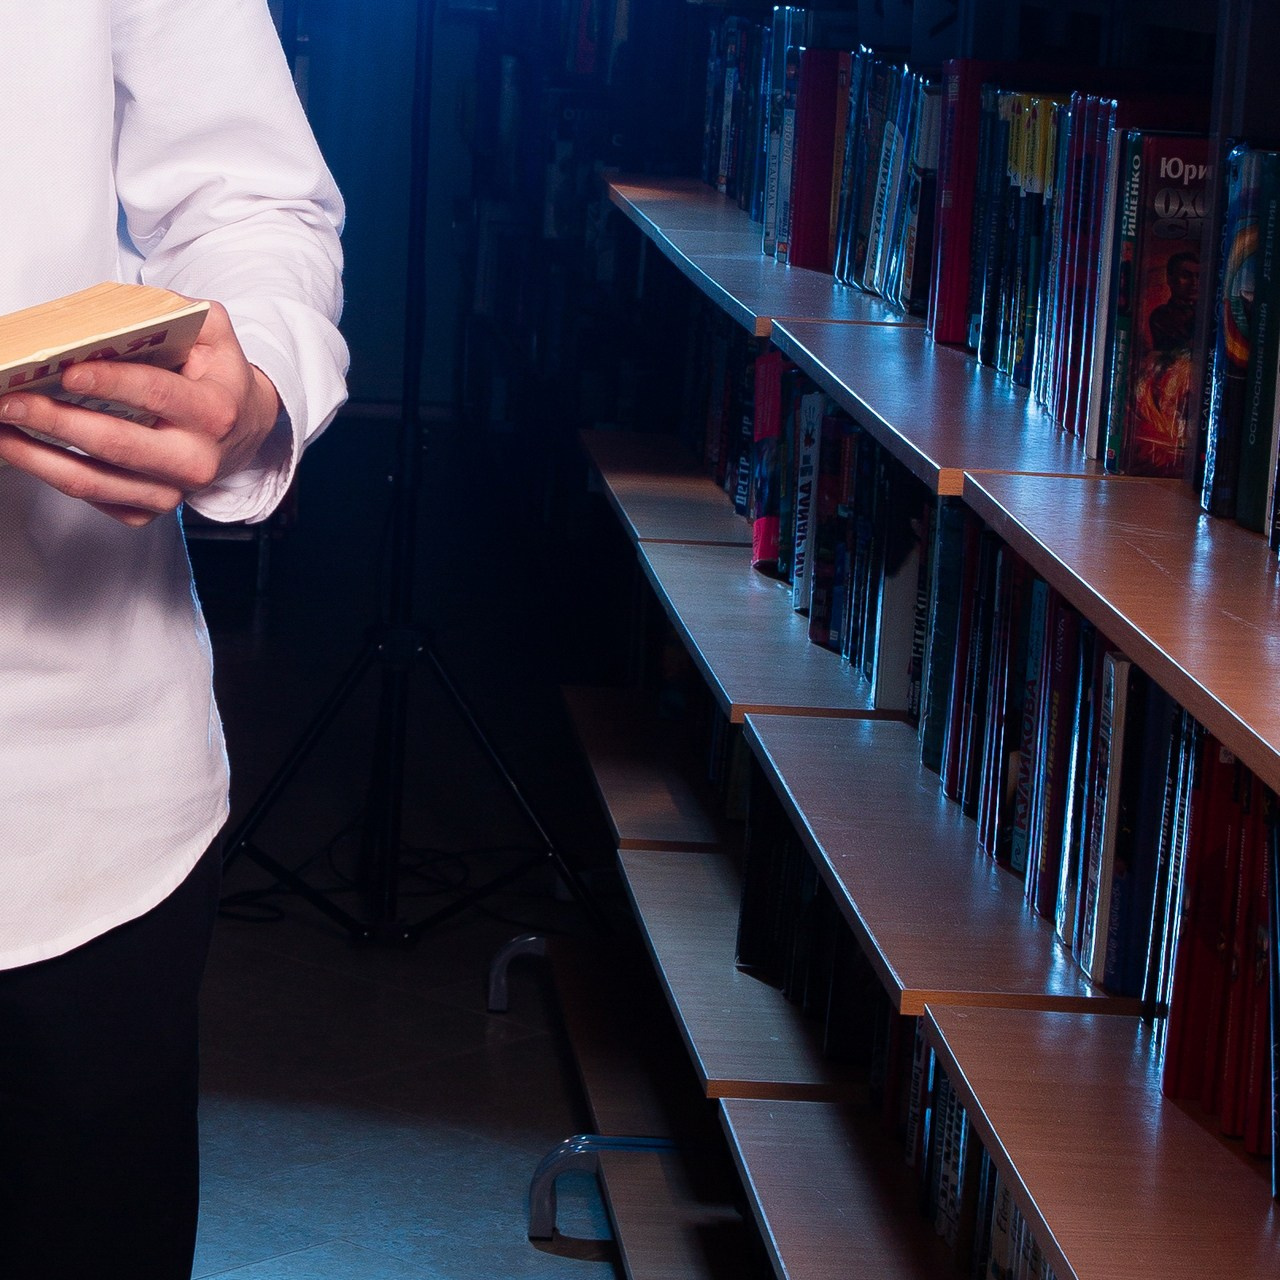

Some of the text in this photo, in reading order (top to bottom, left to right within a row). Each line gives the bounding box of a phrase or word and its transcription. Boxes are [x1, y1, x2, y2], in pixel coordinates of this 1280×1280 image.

[1127, 155, 1141, 237] ИЩЕНКО
[1248, 199, 1277, 445] ОСТРОСЮЖЕТНЫЙ ДЕТЕКТИВ
[1200, 347, 1215, 431] САКВОЯЖ
